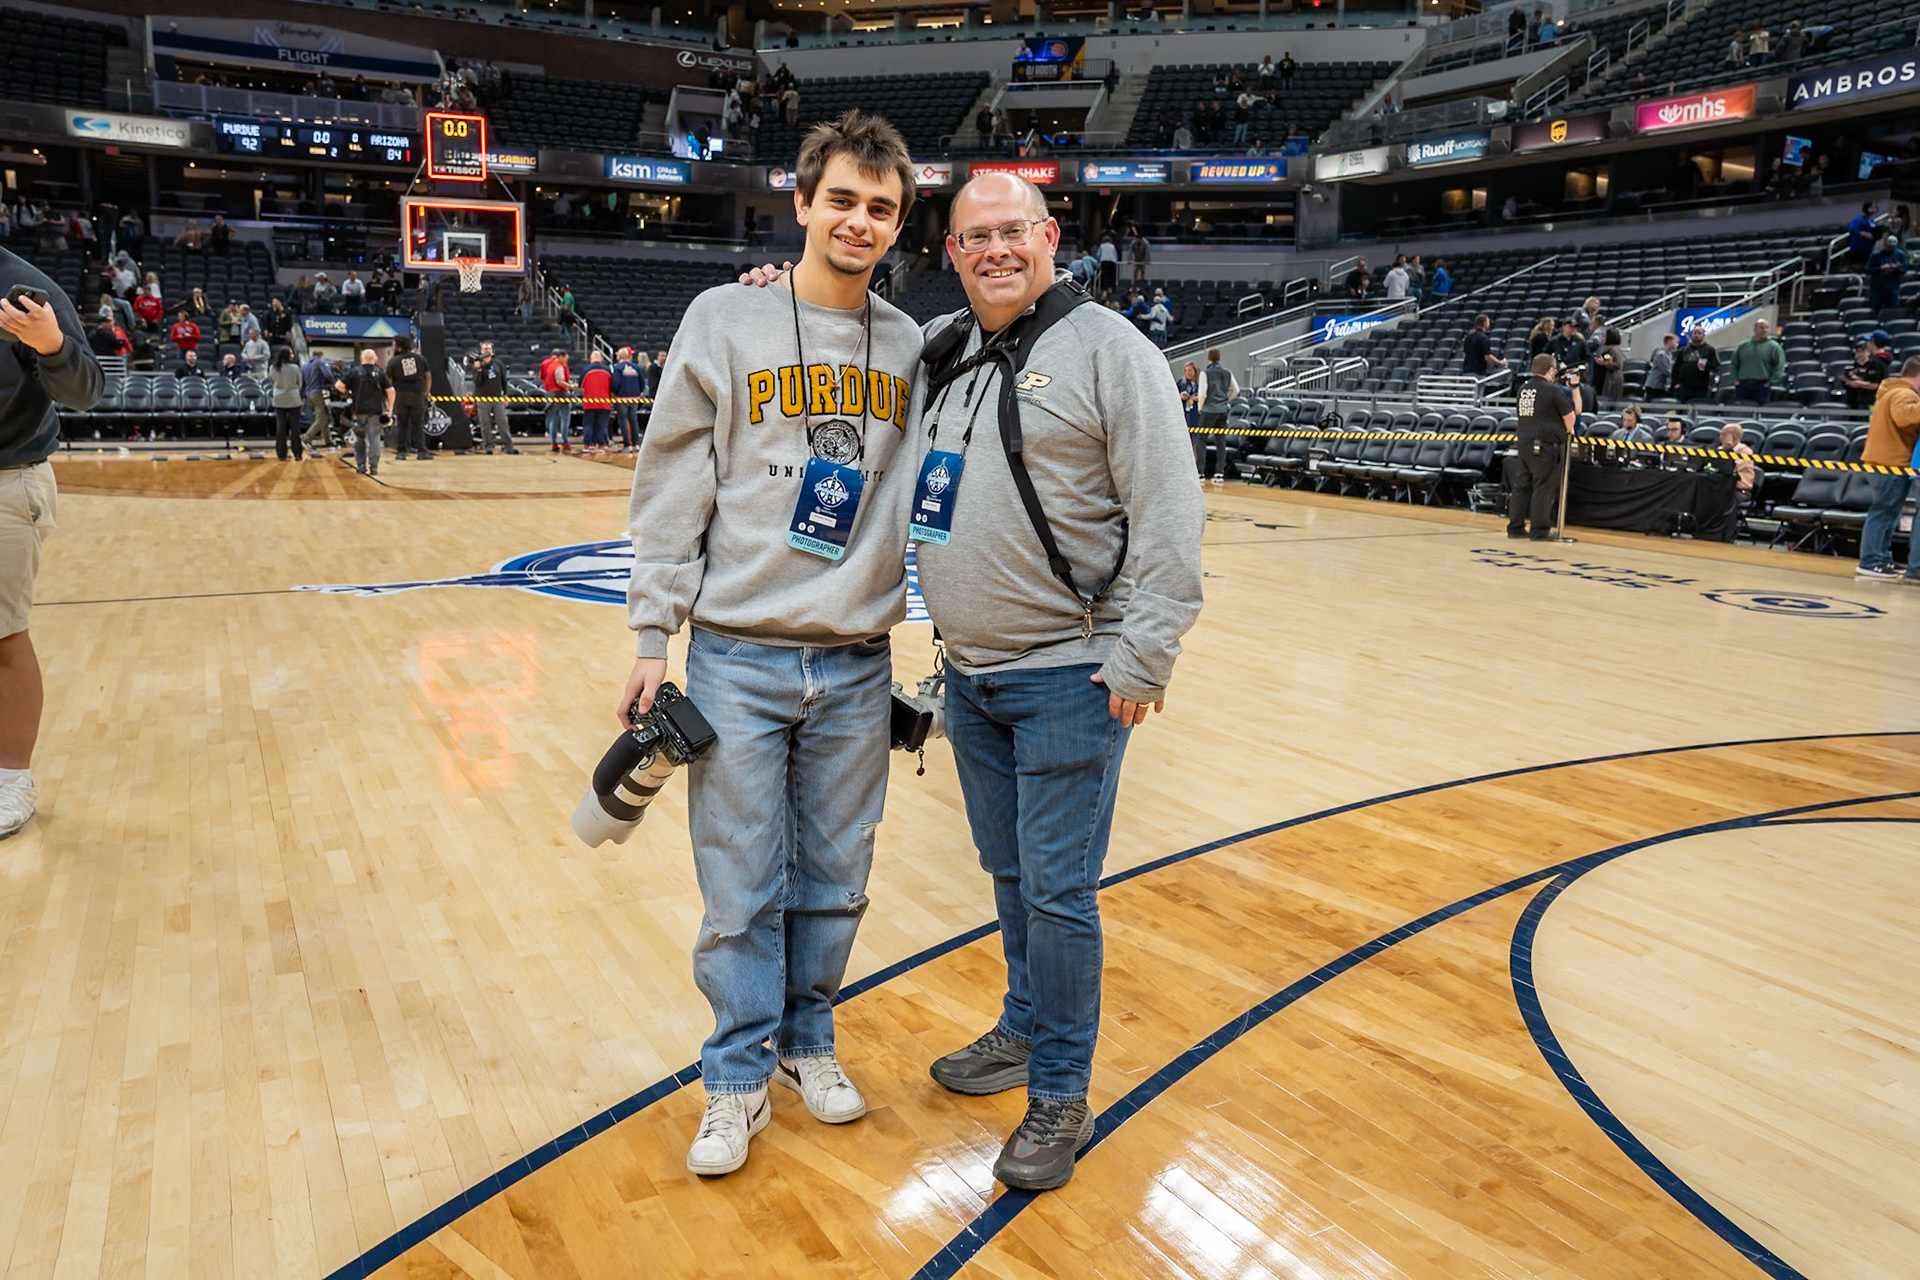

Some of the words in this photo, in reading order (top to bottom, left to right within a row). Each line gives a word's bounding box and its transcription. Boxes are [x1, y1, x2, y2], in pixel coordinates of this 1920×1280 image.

[278, 48, 330, 65] FLIGHT
[698, 55, 752, 71] LEXUS
[1793, 62, 1916, 101] AMBROS
[1682, 96, 1726, 121] mhs
[119, 121, 186, 140] Kinetico
[222, 122, 260, 137] PURDUE
[443, 120, 468, 138] 0.0
[241, 137, 257, 151] 92
[370, 134, 410, 148] ARIZONA
[1422, 139, 1455, 158] Ruoff
[1455, 137, 1489, 151] MORTGAGE
[386, 149, 402, 162] 84
[498, 154, 537, 166] GAMING
[446, 165, 482, 176] TISSOT
[612, 157, 651, 179] ksm
[1017, 166, 1056, 179] SHAKE
[1200, 165, 1248, 178] REVVED
[1247, 165, 1266, 177] UP
[305, 318, 347, 330] Elevance
[747, 363, 910, 432] PURDUE
[1520, 388, 1537, 399] CSC
[1518, 398, 1536, 408] EVENT
[1518, 407, 1535, 417] STAFF
[912, 525, 947, 541] PHOTOGRAPHER
[791, 533, 840, 556] PHOTOGRAPHER
